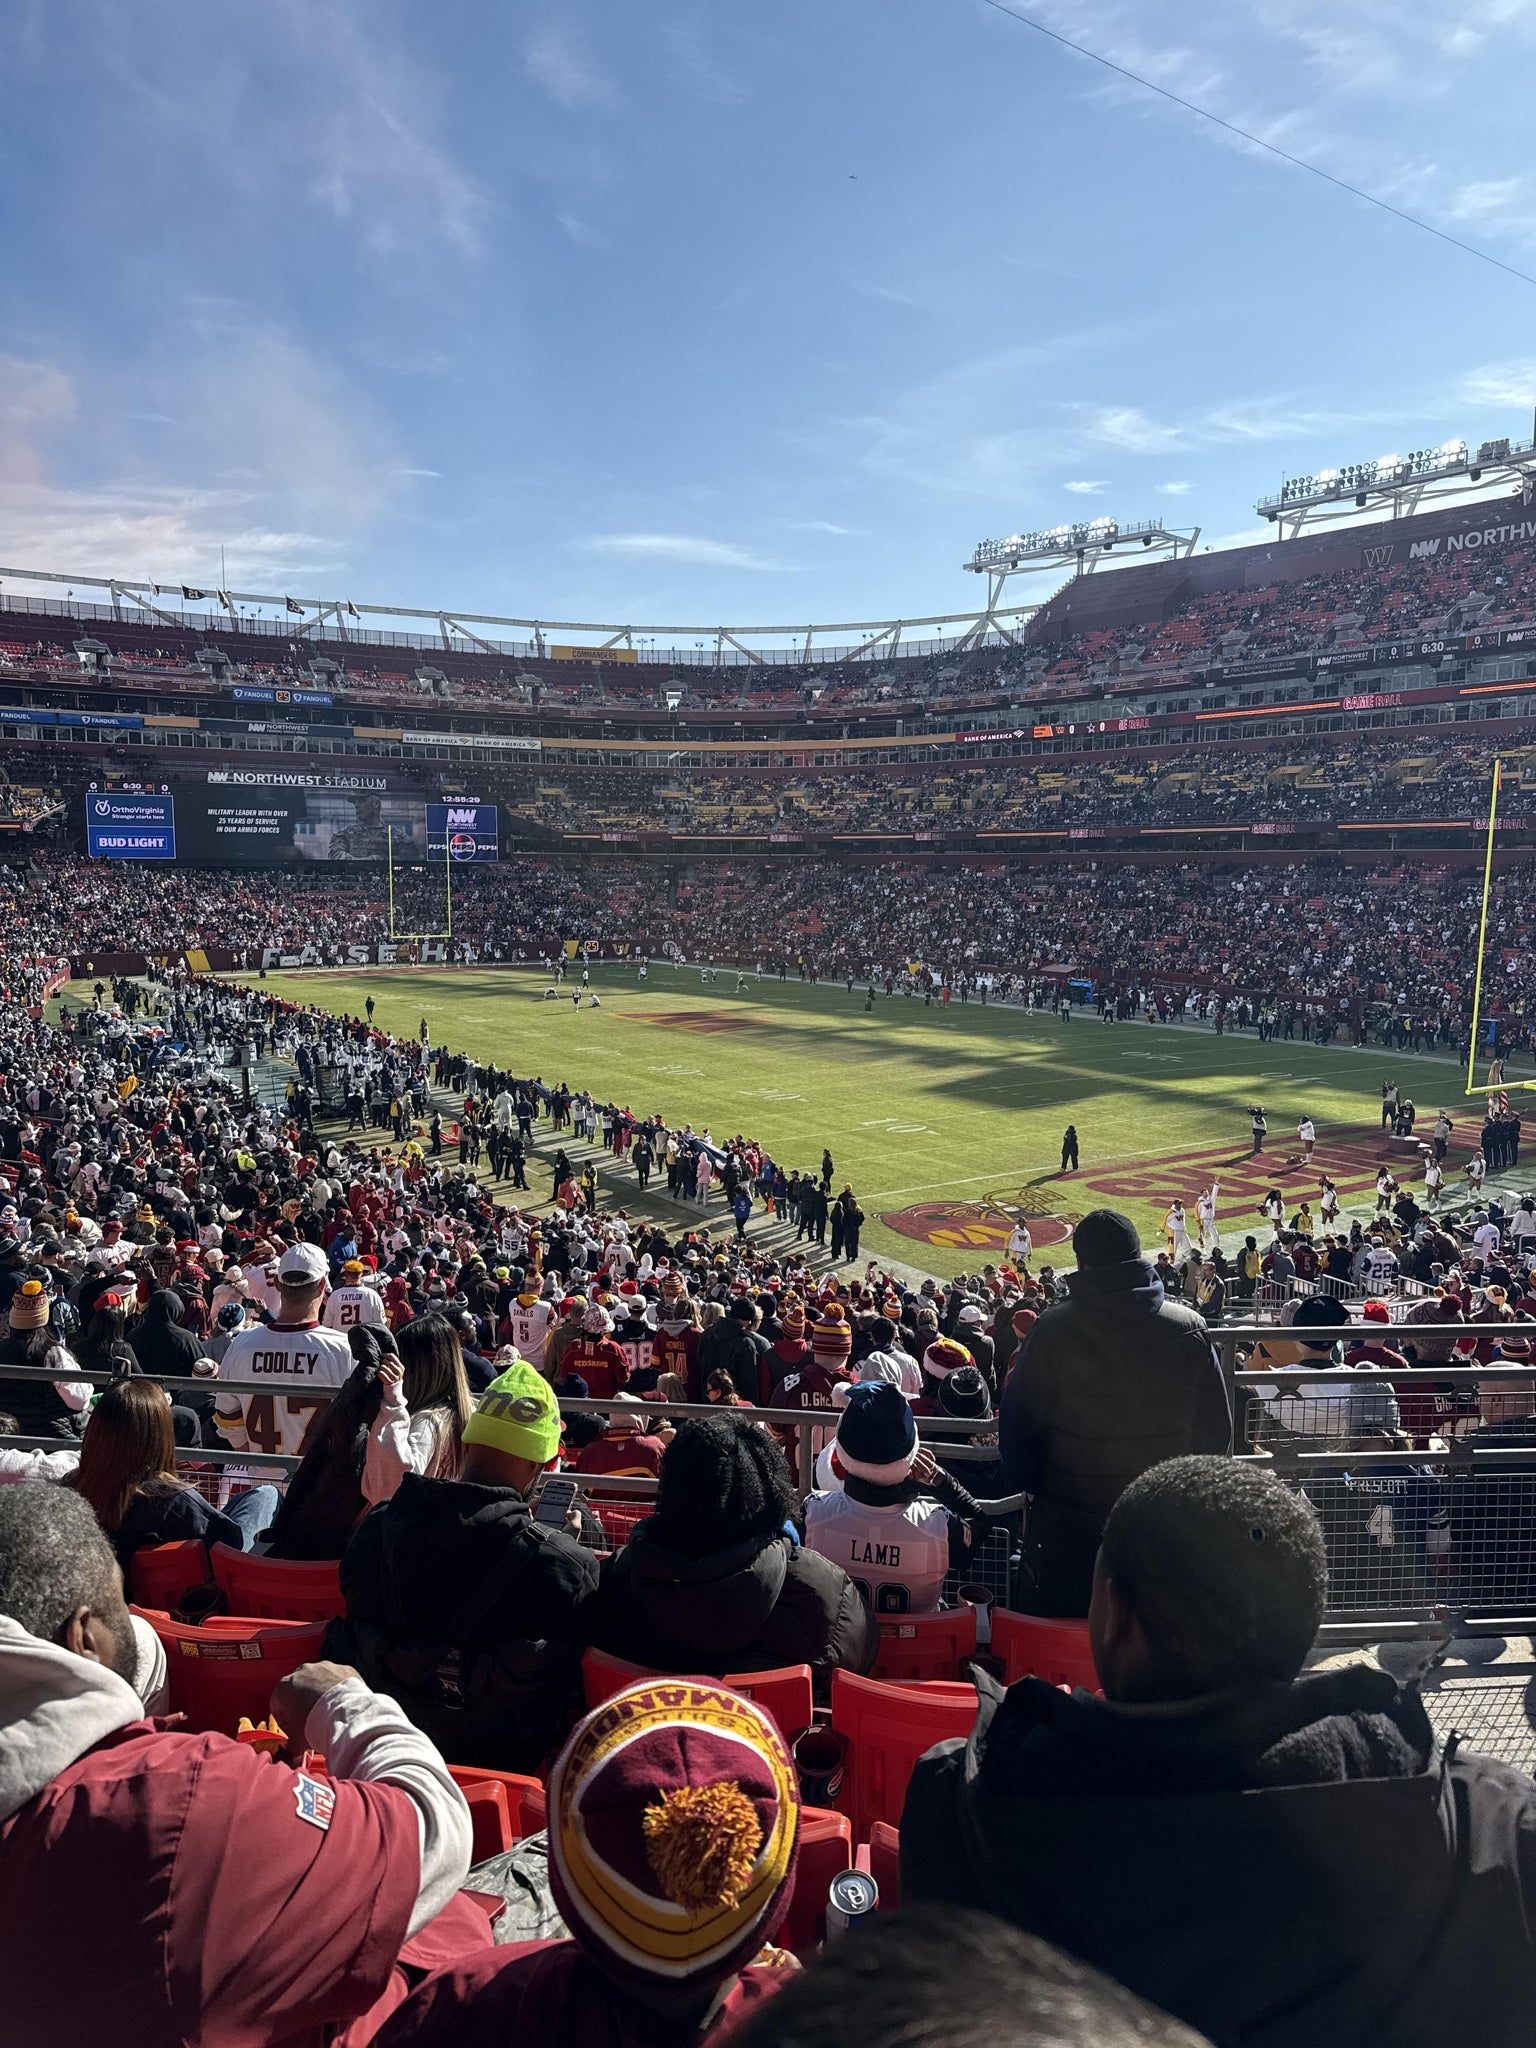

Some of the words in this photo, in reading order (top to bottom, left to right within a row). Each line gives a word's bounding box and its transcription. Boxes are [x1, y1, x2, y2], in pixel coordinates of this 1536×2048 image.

[1409, 539, 1440, 559] NW
[1474, 635, 1481, 645] 0
[1390, 647, 1397, 656] 0
[1421, 641, 1445, 654] 6:30
[572, 650, 618, 660] COMMANDERS
[1316, 656, 1333, 667] NW
[1332, 651, 1369, 662] NORTHWEST
[244, 691, 274, 699] FANDUEL
[277, 692, 289, 701] 25
[302, 695, 332, 703] FANDUEL
[1, 712, 31, 720] FANDUEL
[91, 717, 120, 725] FANDUEL
[248, 723, 267, 732] NW
[987, 732, 1013, 740] AMERICA
[207, 771, 229, 782] NW
[233, 772, 322, 786] NORTHWEST
[325, 776, 386, 789] STADIUM
[89, 781, 98, 790] 0
[161, 784, 169, 792] 0
[442, 795, 481, 804] 12:55:29
[111, 806, 165, 815] OrthoVirginia
[207, 808, 234, 816] MILITARY
[235, 809, 257, 817] LEADER
[257, 809, 272, 817] WITH
[446, 808, 477, 823] NW
[218, 817, 227, 825] 25
[227, 817, 246, 825] YEARS
[255, 818, 279, 826] SERVICE
[1473, 817, 1502, 830] GAE
[236, 826, 258, 834] ARMED
[98, 837, 127, 848] BUD
[127, 838, 165, 848] LIGHT
[586, 941, 597, 950] 25
[504, 1239, 519, 1251] 55
[1372, 1262, 1392, 1279] 22
[341, 1293, 363, 1302] TAYLOR
[340, 1304, 361, 1326] 21
[513, 1308, 534, 1318] DANIELS
[519, 1321, 529, 1343] 5
[665, 1340, 686, 1351] HOWELL
[621, 1340, 654, 1372] 88
[252, 1351, 320, 1375] COOLEY
[573, 1359, 609, 1369] REDSKINS
[665, 1352, 688, 1385] 14
[1349, 1479, 1408, 1495] PRESCOTT
[1364, 1504, 1395, 1548] 4
[850, 1539, 901, 1567] LAMB
[315, 1790, 333, 1822] NFL
